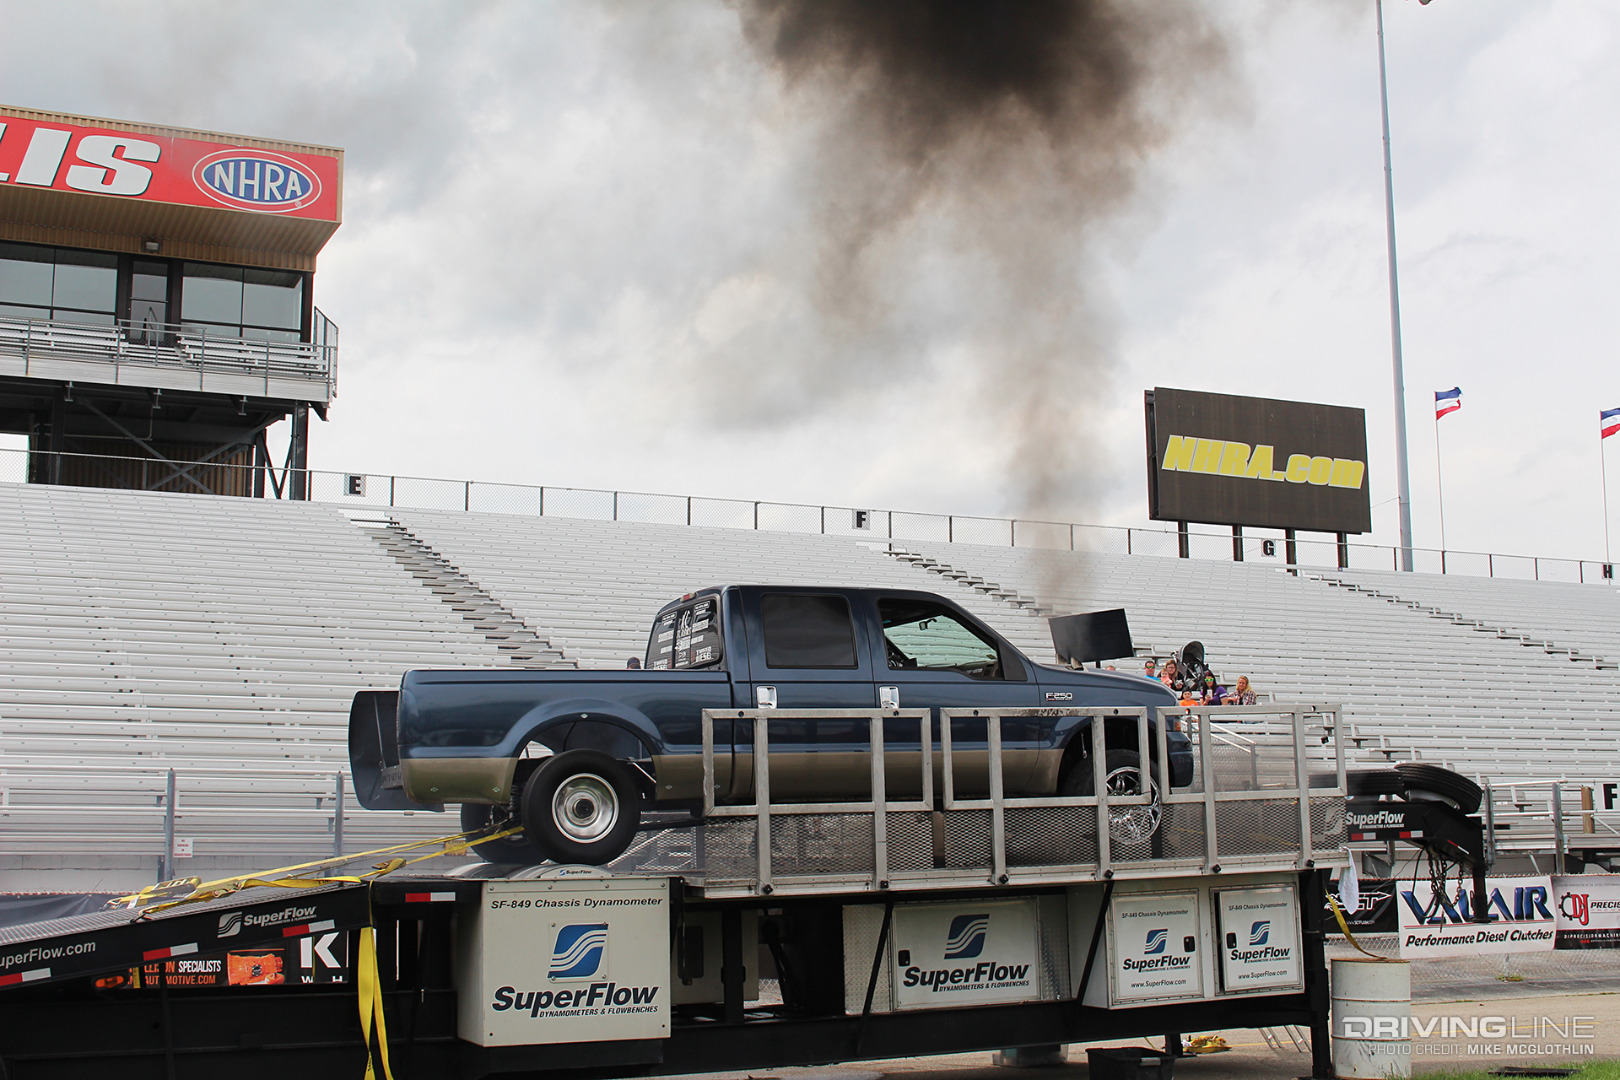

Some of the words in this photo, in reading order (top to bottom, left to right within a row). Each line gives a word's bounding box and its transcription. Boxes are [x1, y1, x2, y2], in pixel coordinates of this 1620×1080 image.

[214, 161, 302, 200] NHRA
[1161, 434, 1366, 490] NHRA.com
[349, 475, 361, 495] E
[856, 511, 867, 528] F
[1263, 540, 1275, 556] G
[1602, 564, 1613, 579] H
[1603, 783, 1618, 810] F
[1345, 811, 1405, 829] SuperFlow
[491, 900, 531, 909] SF-849
[534, 898, 580, 908] Chassis
[584, 897, 663, 908] Dynamometer
[243, 905, 317, 928] SuperFlow
[1405, 934, 1475, 947] Performance
[1476, 930, 1509, 943] Diesel
[1510, 929, 1553, 941] Clutches
[1122, 955, 1191, 972] SuperFlow
[1230, 947, 1290, 963] SuperFlow
[178, 960, 221, 973] SPECIALISTS
[903, 962, 1030, 992] SuperFlow
[1131, 980, 1186, 988] www.SuperFlow.com
[939, 983, 984, 992] DYNAMOMETERS
[991, 981, 1029, 989] FLOWBENCHES
[492, 982, 659, 1018] SuperFlow
[539, 1009, 598, 1018] DYNAMOMETERS
[607, 1006, 658, 1014] FLOWBENCHES
